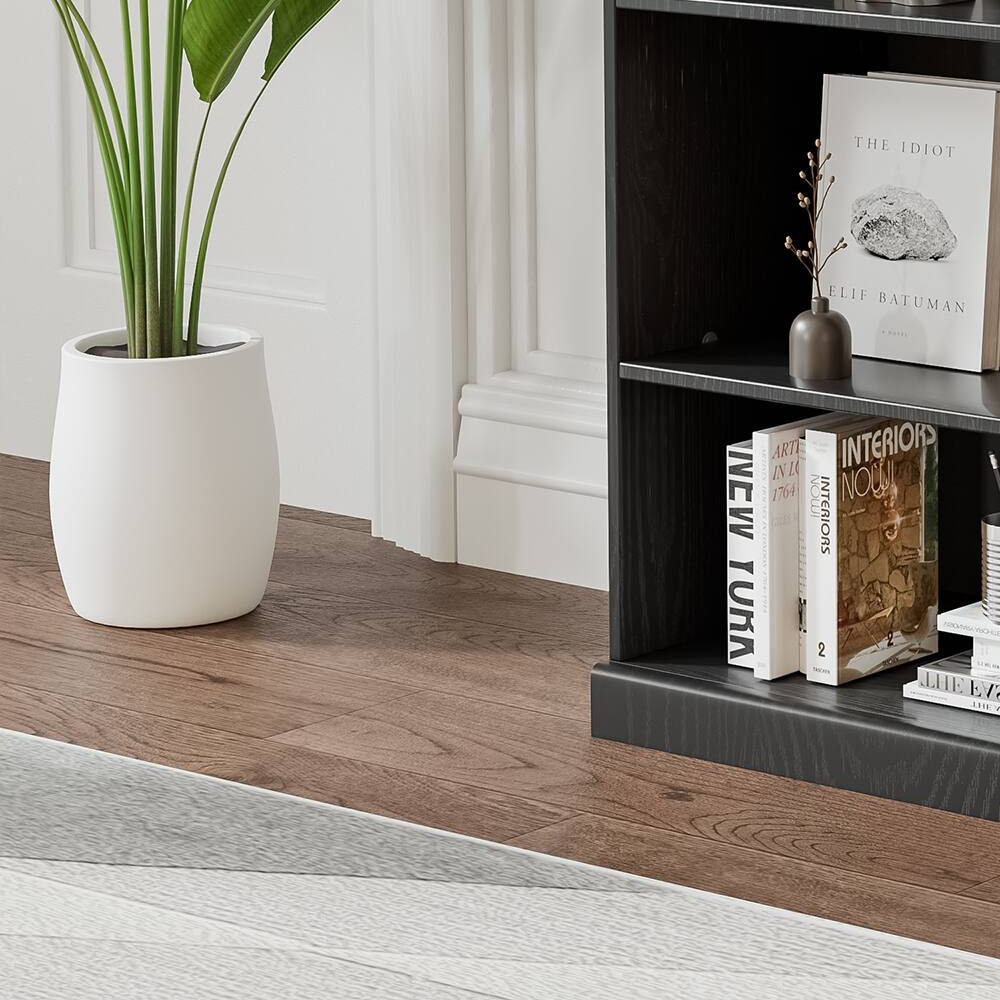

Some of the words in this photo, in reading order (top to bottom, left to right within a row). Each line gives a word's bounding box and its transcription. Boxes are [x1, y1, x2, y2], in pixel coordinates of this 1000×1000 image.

[853, 135, 890, 151] THE
[901, 141, 956, 158] IDIOT
[828, 284, 869, 302] ELIF
[879, 291, 966, 314] BATUMAN
[842, 422, 937, 469] INTERIORS
[772, 463, 787, 481] IN
[810, 473, 820, 518] NOW!
[820, 475, 831, 555] INTERIORS
[818, 642, 826, 658] 2
